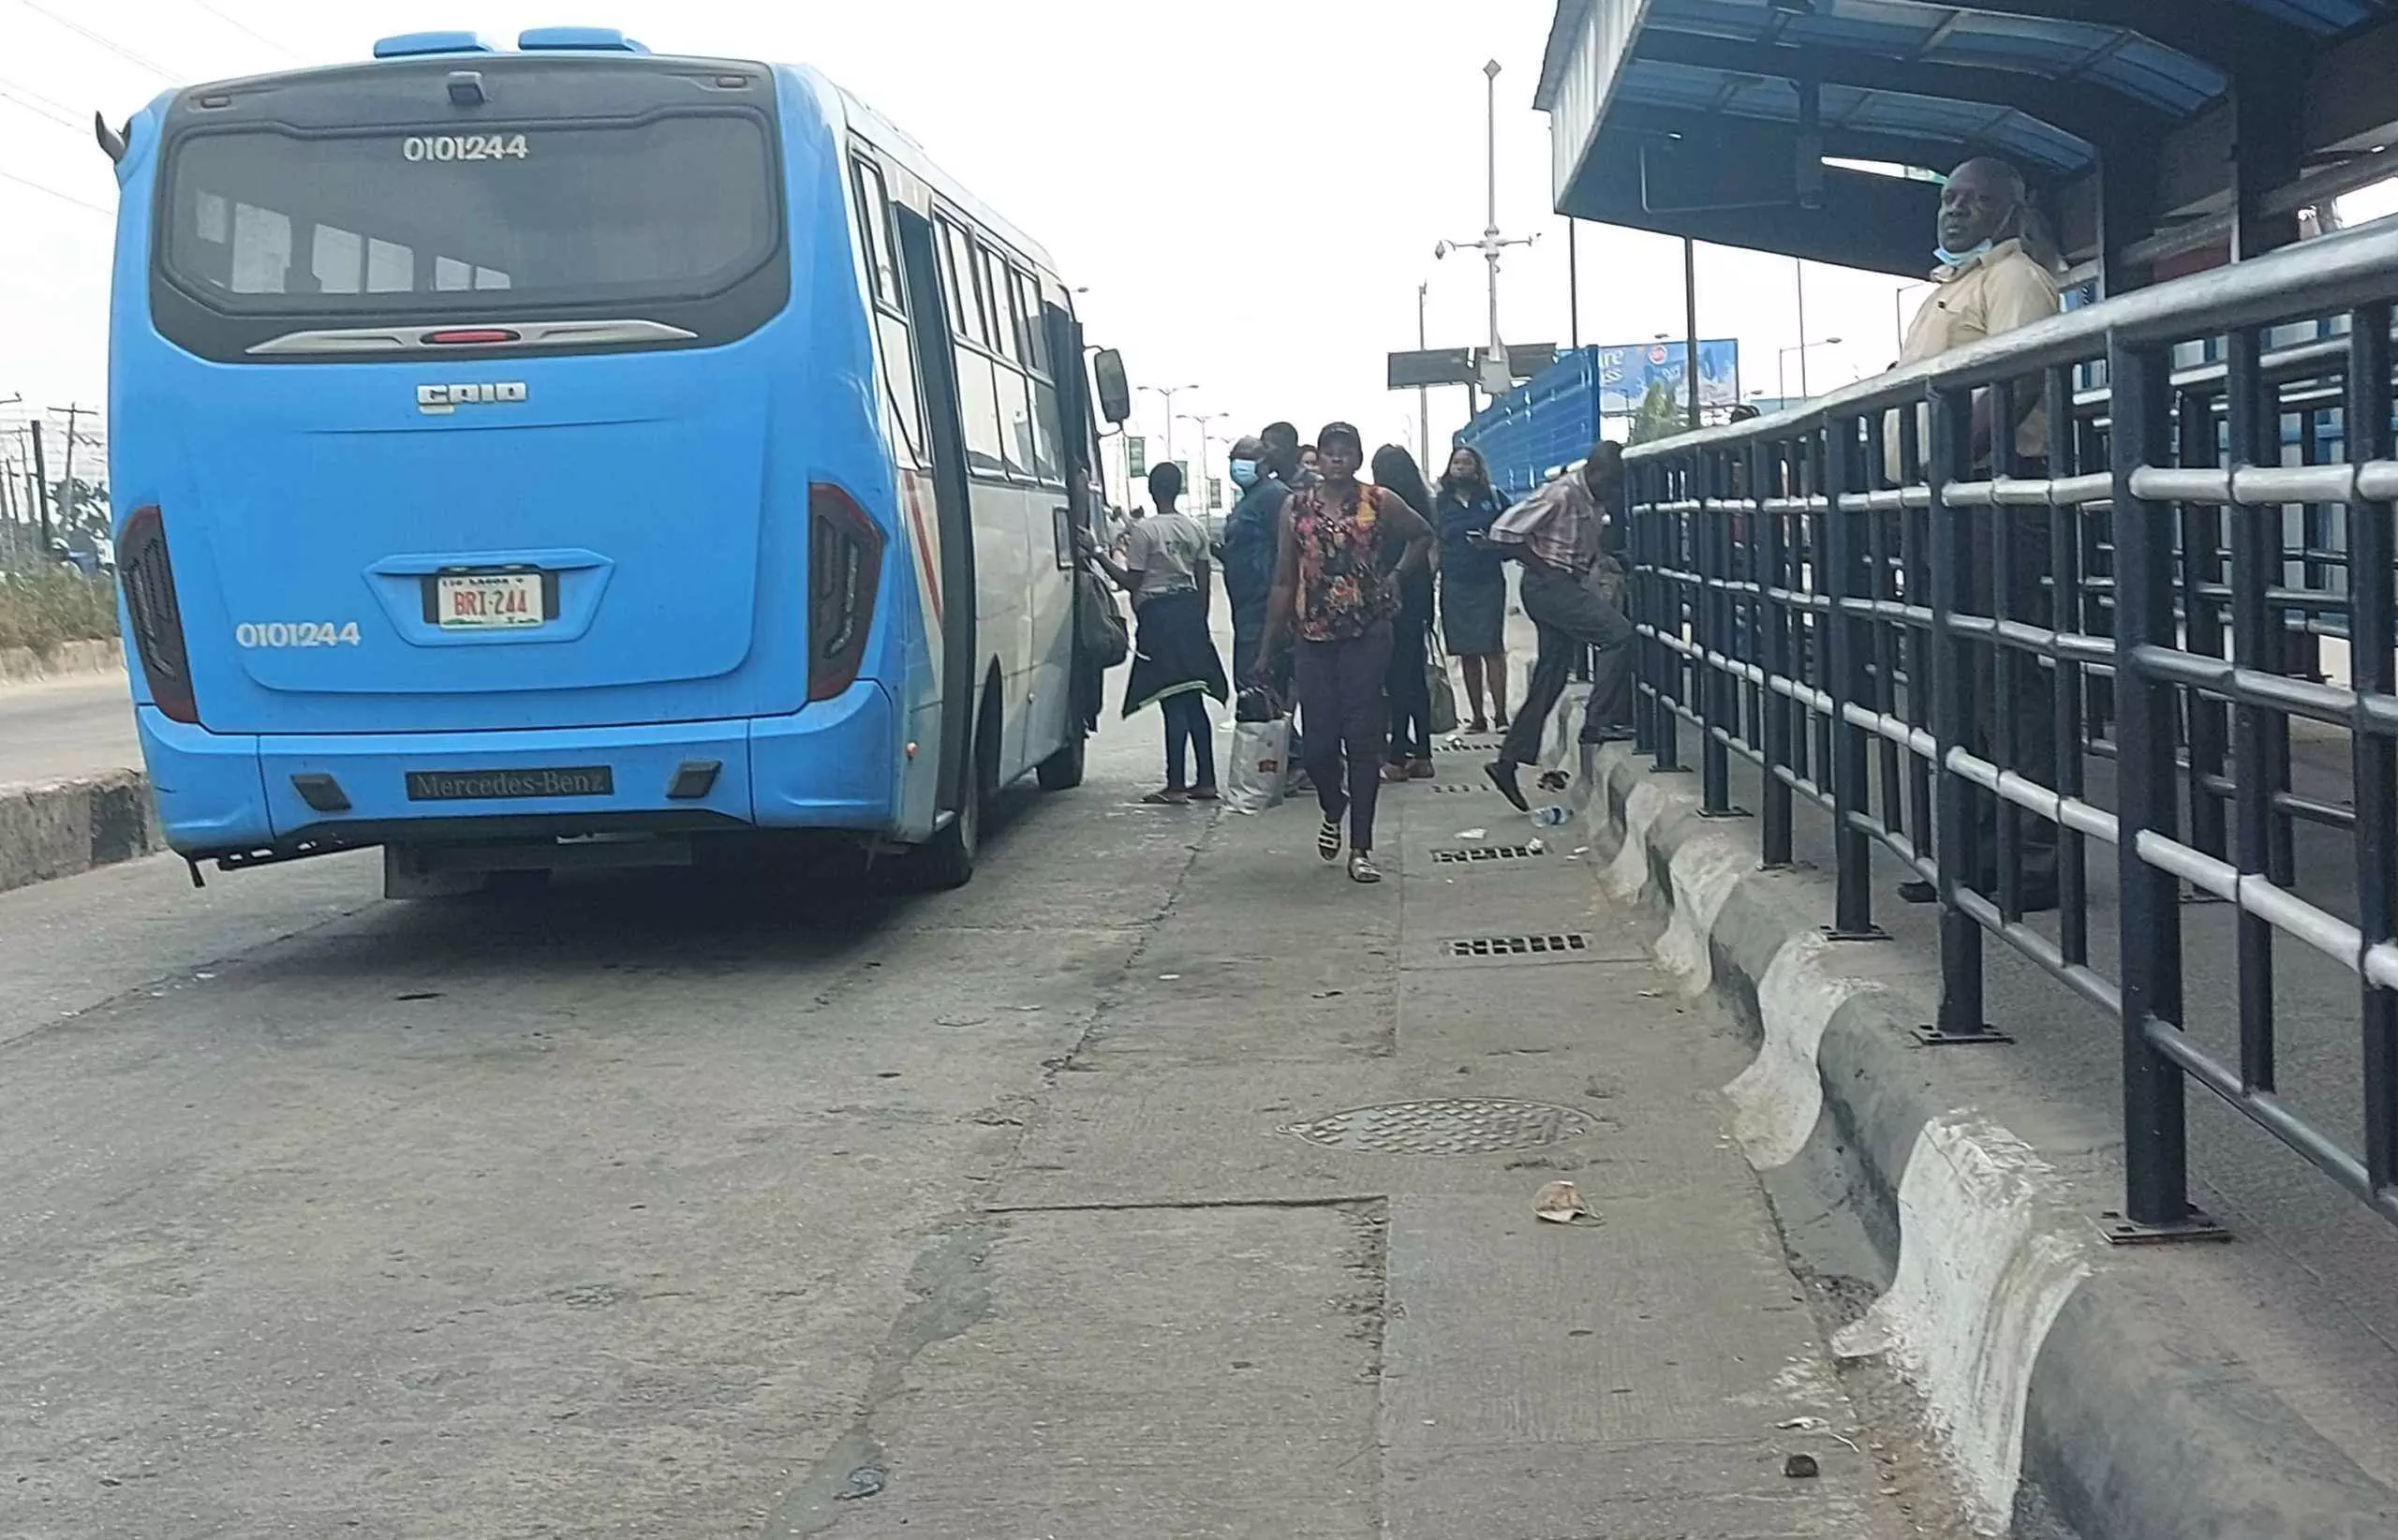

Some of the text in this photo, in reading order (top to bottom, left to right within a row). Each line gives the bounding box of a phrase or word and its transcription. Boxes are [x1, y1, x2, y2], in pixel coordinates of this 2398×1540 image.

[404, 135, 529, 161] 0101244
[236, 622, 362, 648] 0101244
[416, 771, 605, 796] Mercedes-Benz
